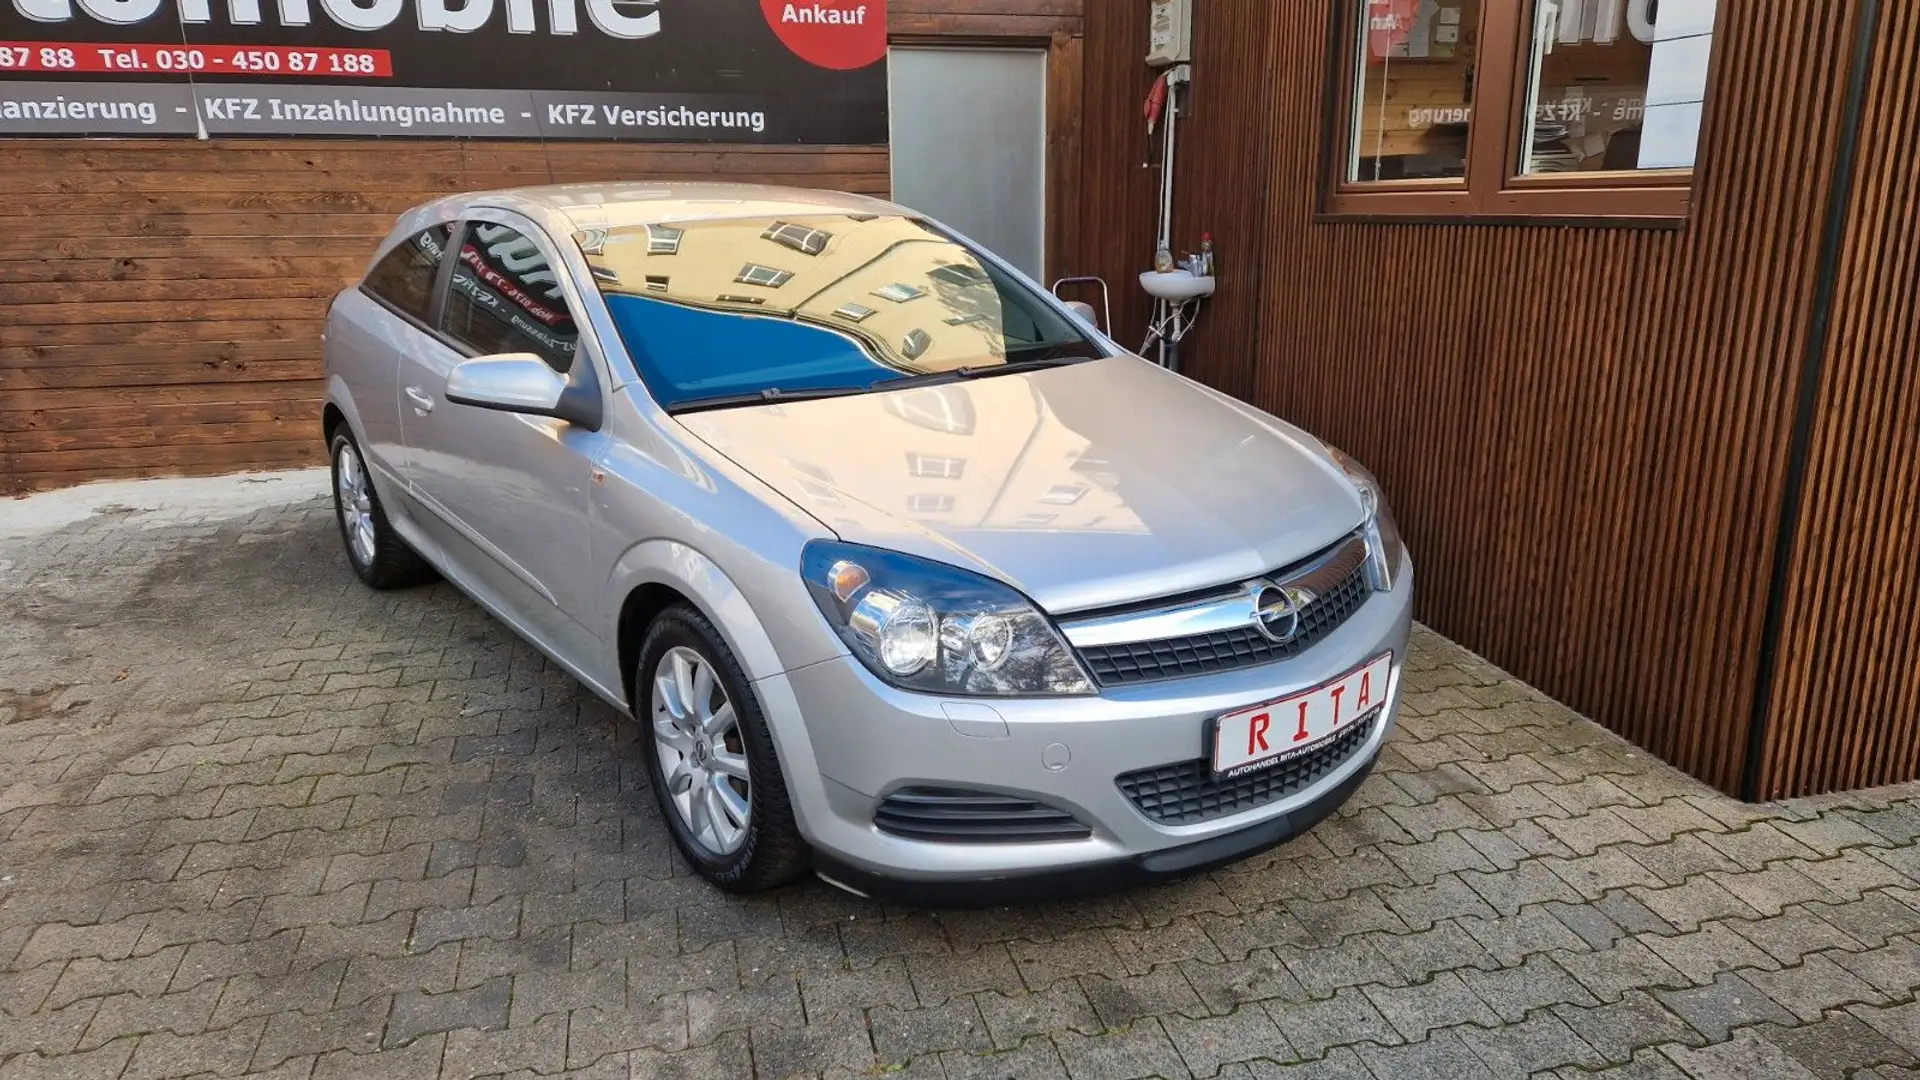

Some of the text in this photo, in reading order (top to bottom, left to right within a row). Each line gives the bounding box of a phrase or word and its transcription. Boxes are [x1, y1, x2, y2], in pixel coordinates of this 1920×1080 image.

[781, 4, 867, 25] Ankauf
[0, 47, 30, 67] 87
[40, 48, 76, 68] 88
[98, 49, 149, 69] Tel.
[156, 50, 205, 70] 030
[231, 51, 280, 71] 450
[288, 52, 319, 71] 87
[329, 53, 376, 73] 188
[0, 95, 157, 125] anzierung
[204, 98, 262, 119] KFZ
[268, 99, 505, 127] Inzahlungnahme
[547, 104, 597, 126] KFZ
[603, 105, 766, 132] Versicherung
[1227, 756, 1279, 778] AUTOHANDEL
